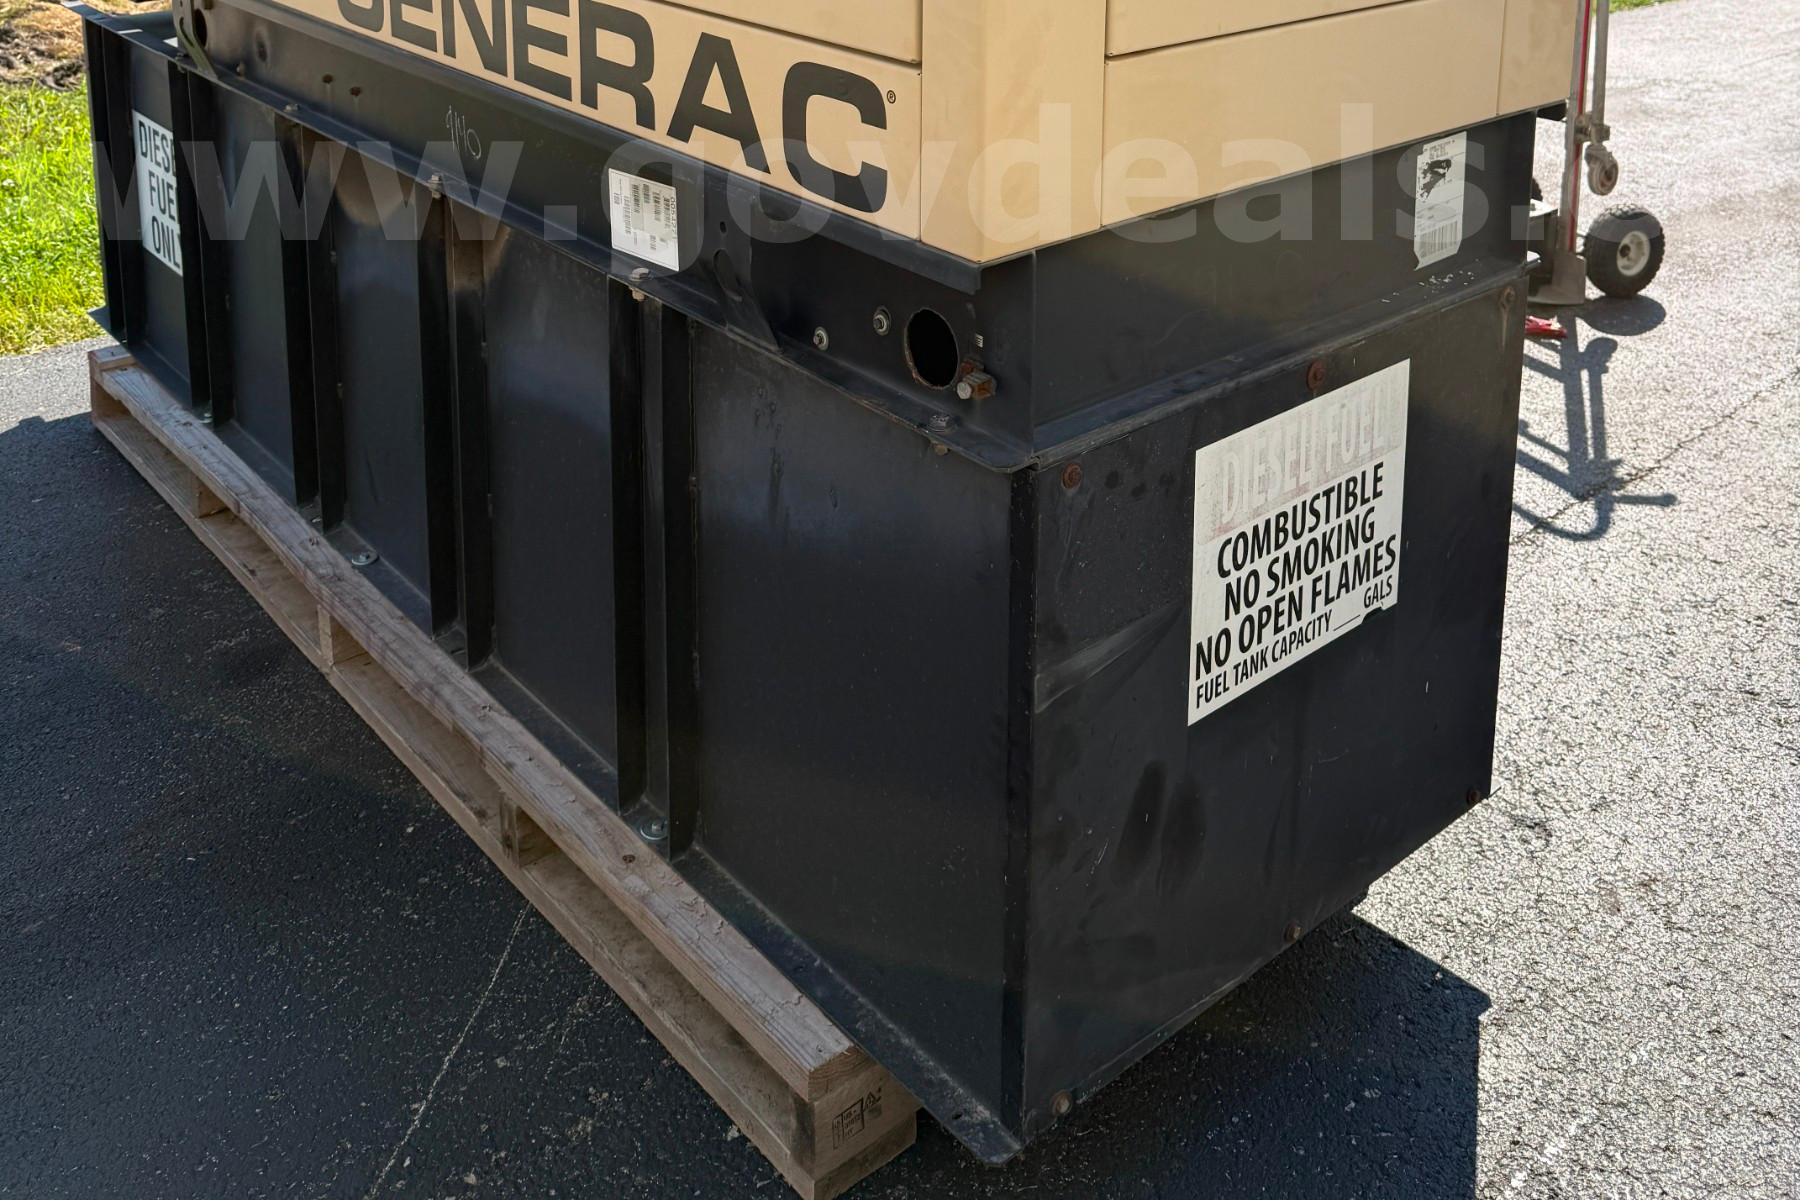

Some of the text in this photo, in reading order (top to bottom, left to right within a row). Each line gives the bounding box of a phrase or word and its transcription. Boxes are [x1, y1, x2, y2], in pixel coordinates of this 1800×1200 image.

[138, 119, 176, 177] DIES
[148, 168, 178, 224] FUE
[151, 215, 181, 269] ONL
[1217, 461, 1384, 579] COMBUSTIBLE
[1224, 506, 1375, 622] NO SMOKING
[1195, 534, 1397, 681] NO OPEN FLAMES
[1196, 575, 1393, 709] FUEL TANK CAPACITY GALS
